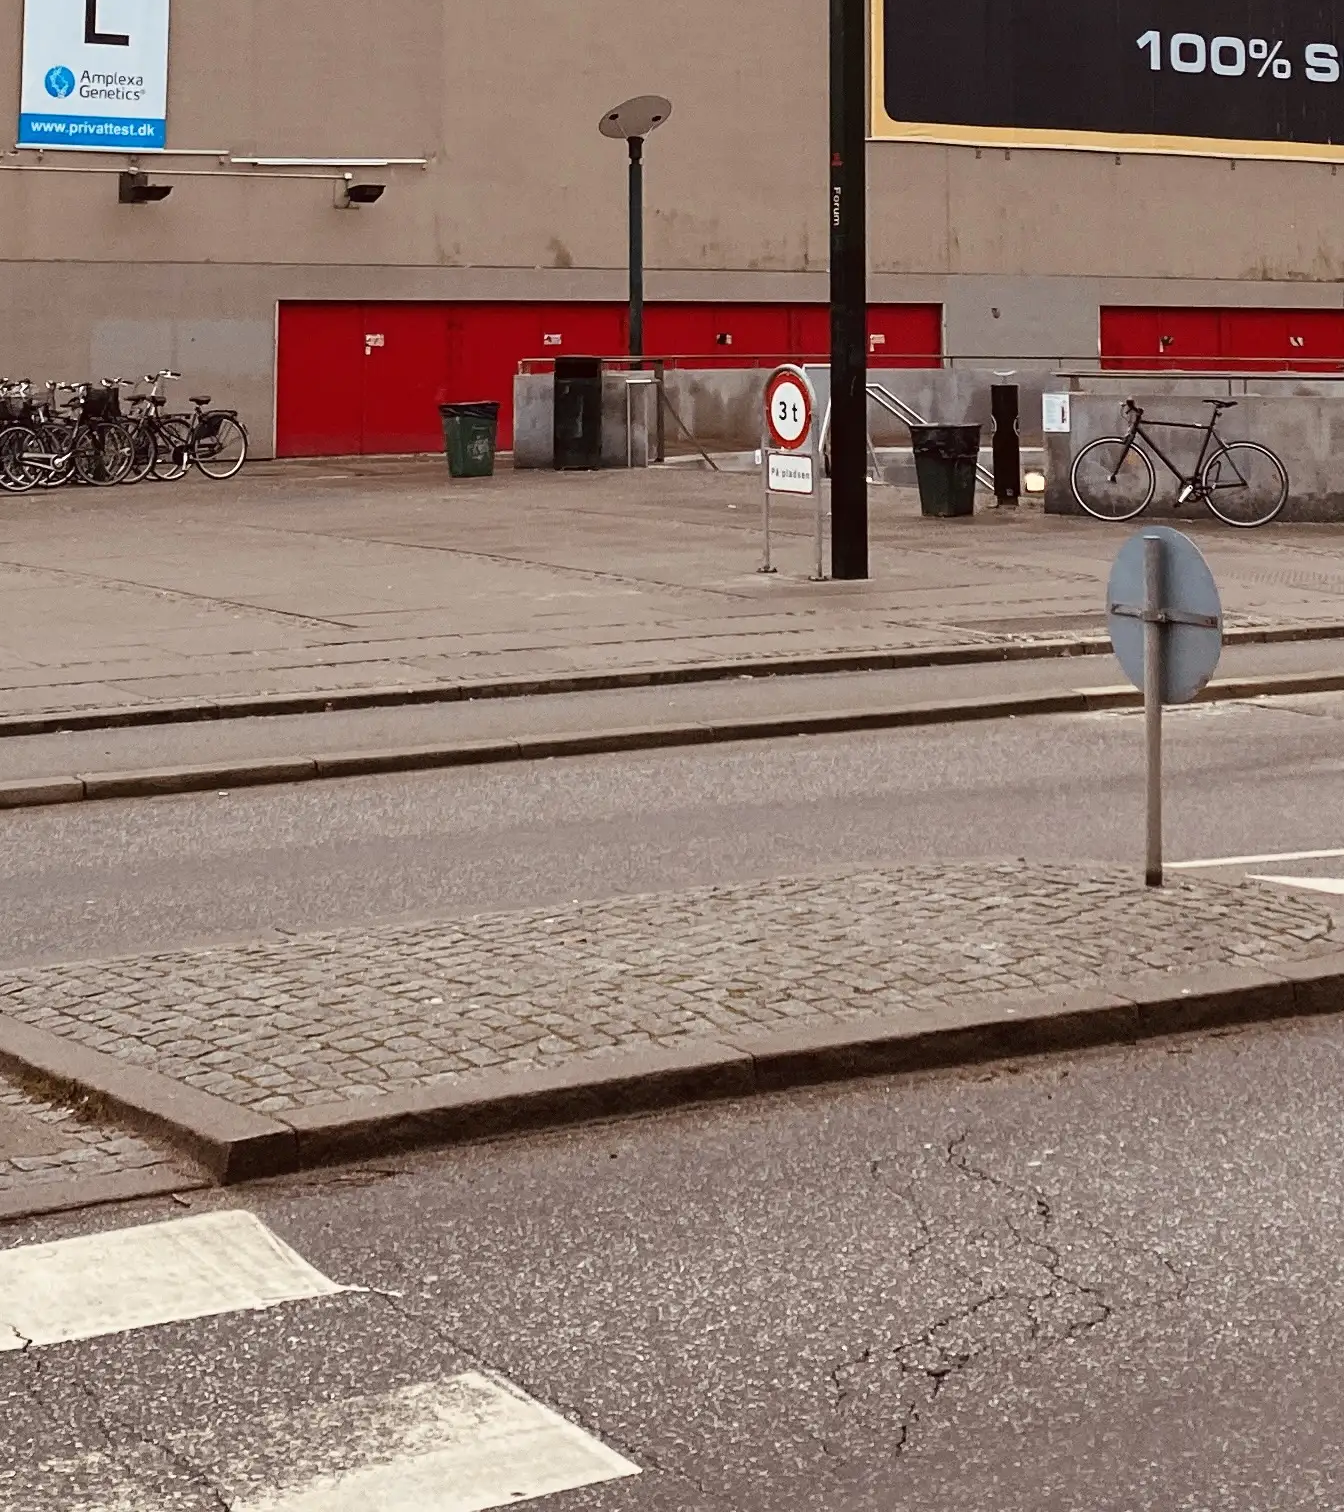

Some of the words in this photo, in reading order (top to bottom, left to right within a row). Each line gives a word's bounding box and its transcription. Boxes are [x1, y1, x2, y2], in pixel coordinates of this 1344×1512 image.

[1136, 30, 1291, 79] 100%
[80, 70, 143, 86] Amplexa
[31, 121, 155, 136] www.privattest.dk
[833, 186, 841, 226] Forum
[779, 401, 787, 420] 3
[792, 403, 798, 422] t
